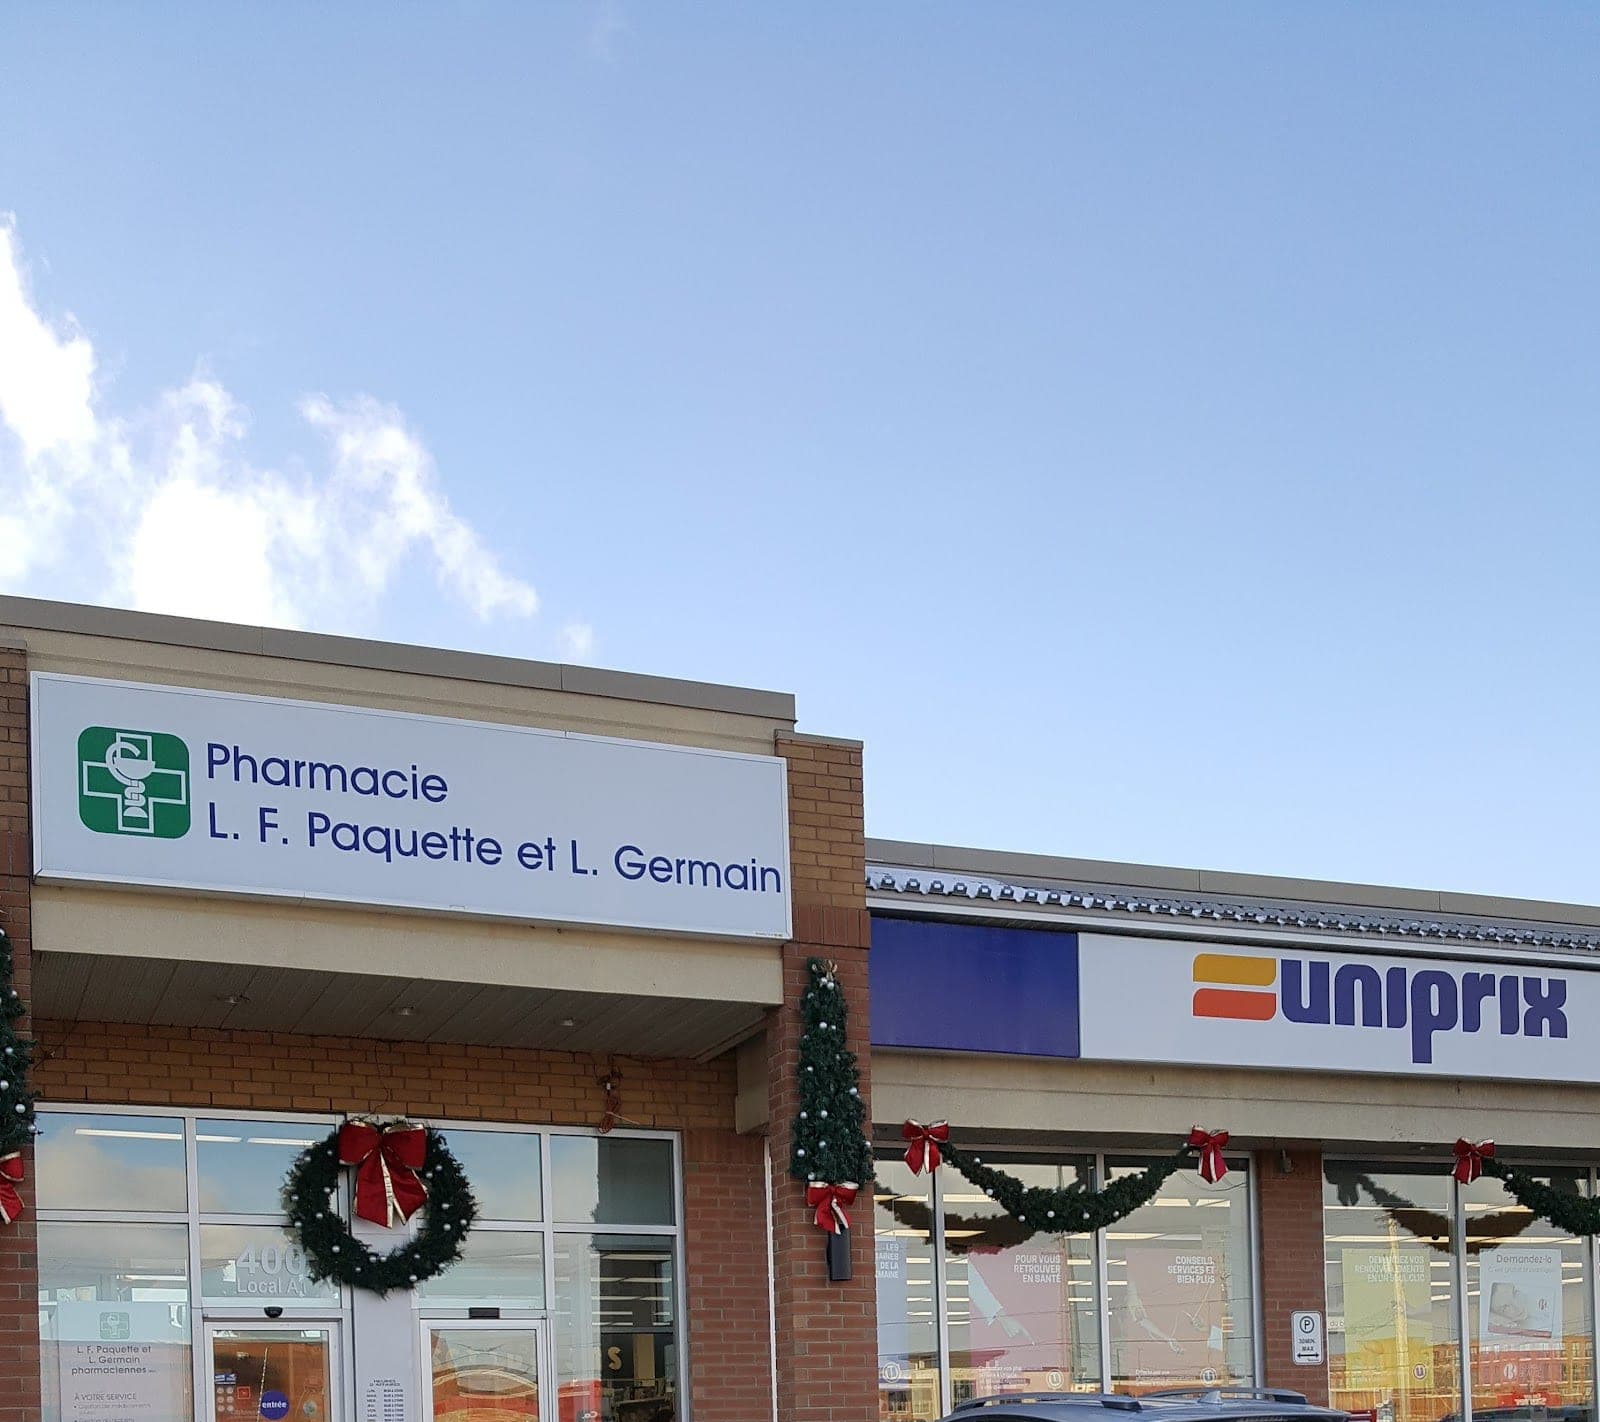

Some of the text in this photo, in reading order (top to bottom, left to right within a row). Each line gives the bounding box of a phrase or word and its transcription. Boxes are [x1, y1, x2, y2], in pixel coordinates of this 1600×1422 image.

[207, 742, 449, 803] Pharmacie
[208, 801, 782, 894] L. F. Paquette et L. Germain
[1280, 958, 1568, 1065] uniprix
[1015, 1254, 1061, 1264] POUR VOUS
[1496, 1254, 1552, 1264] Demandez-la
[1013, 1264, 1061, 1274] RETROUVER
[1167, 1265, 1215, 1274] SERVICES ET
[1022, 1273, 1061, 1283] EN SANTÉ
[1177, 1275, 1215, 1284] BIEN PLUS
[237, 1277, 282, 1294] Local
[96, 1345, 139, 1355] Paquette
[142, 1345, 152, 1353] et
[88, 1356, 141, 1364] L. Germain
[71, 1366, 148, 1376] pharmaciennes
[80, 1393, 105, 1401] VOTRE
[106, 1393, 137, 1401] SERVICE
[261, 1400, 288, 1409] entrée
